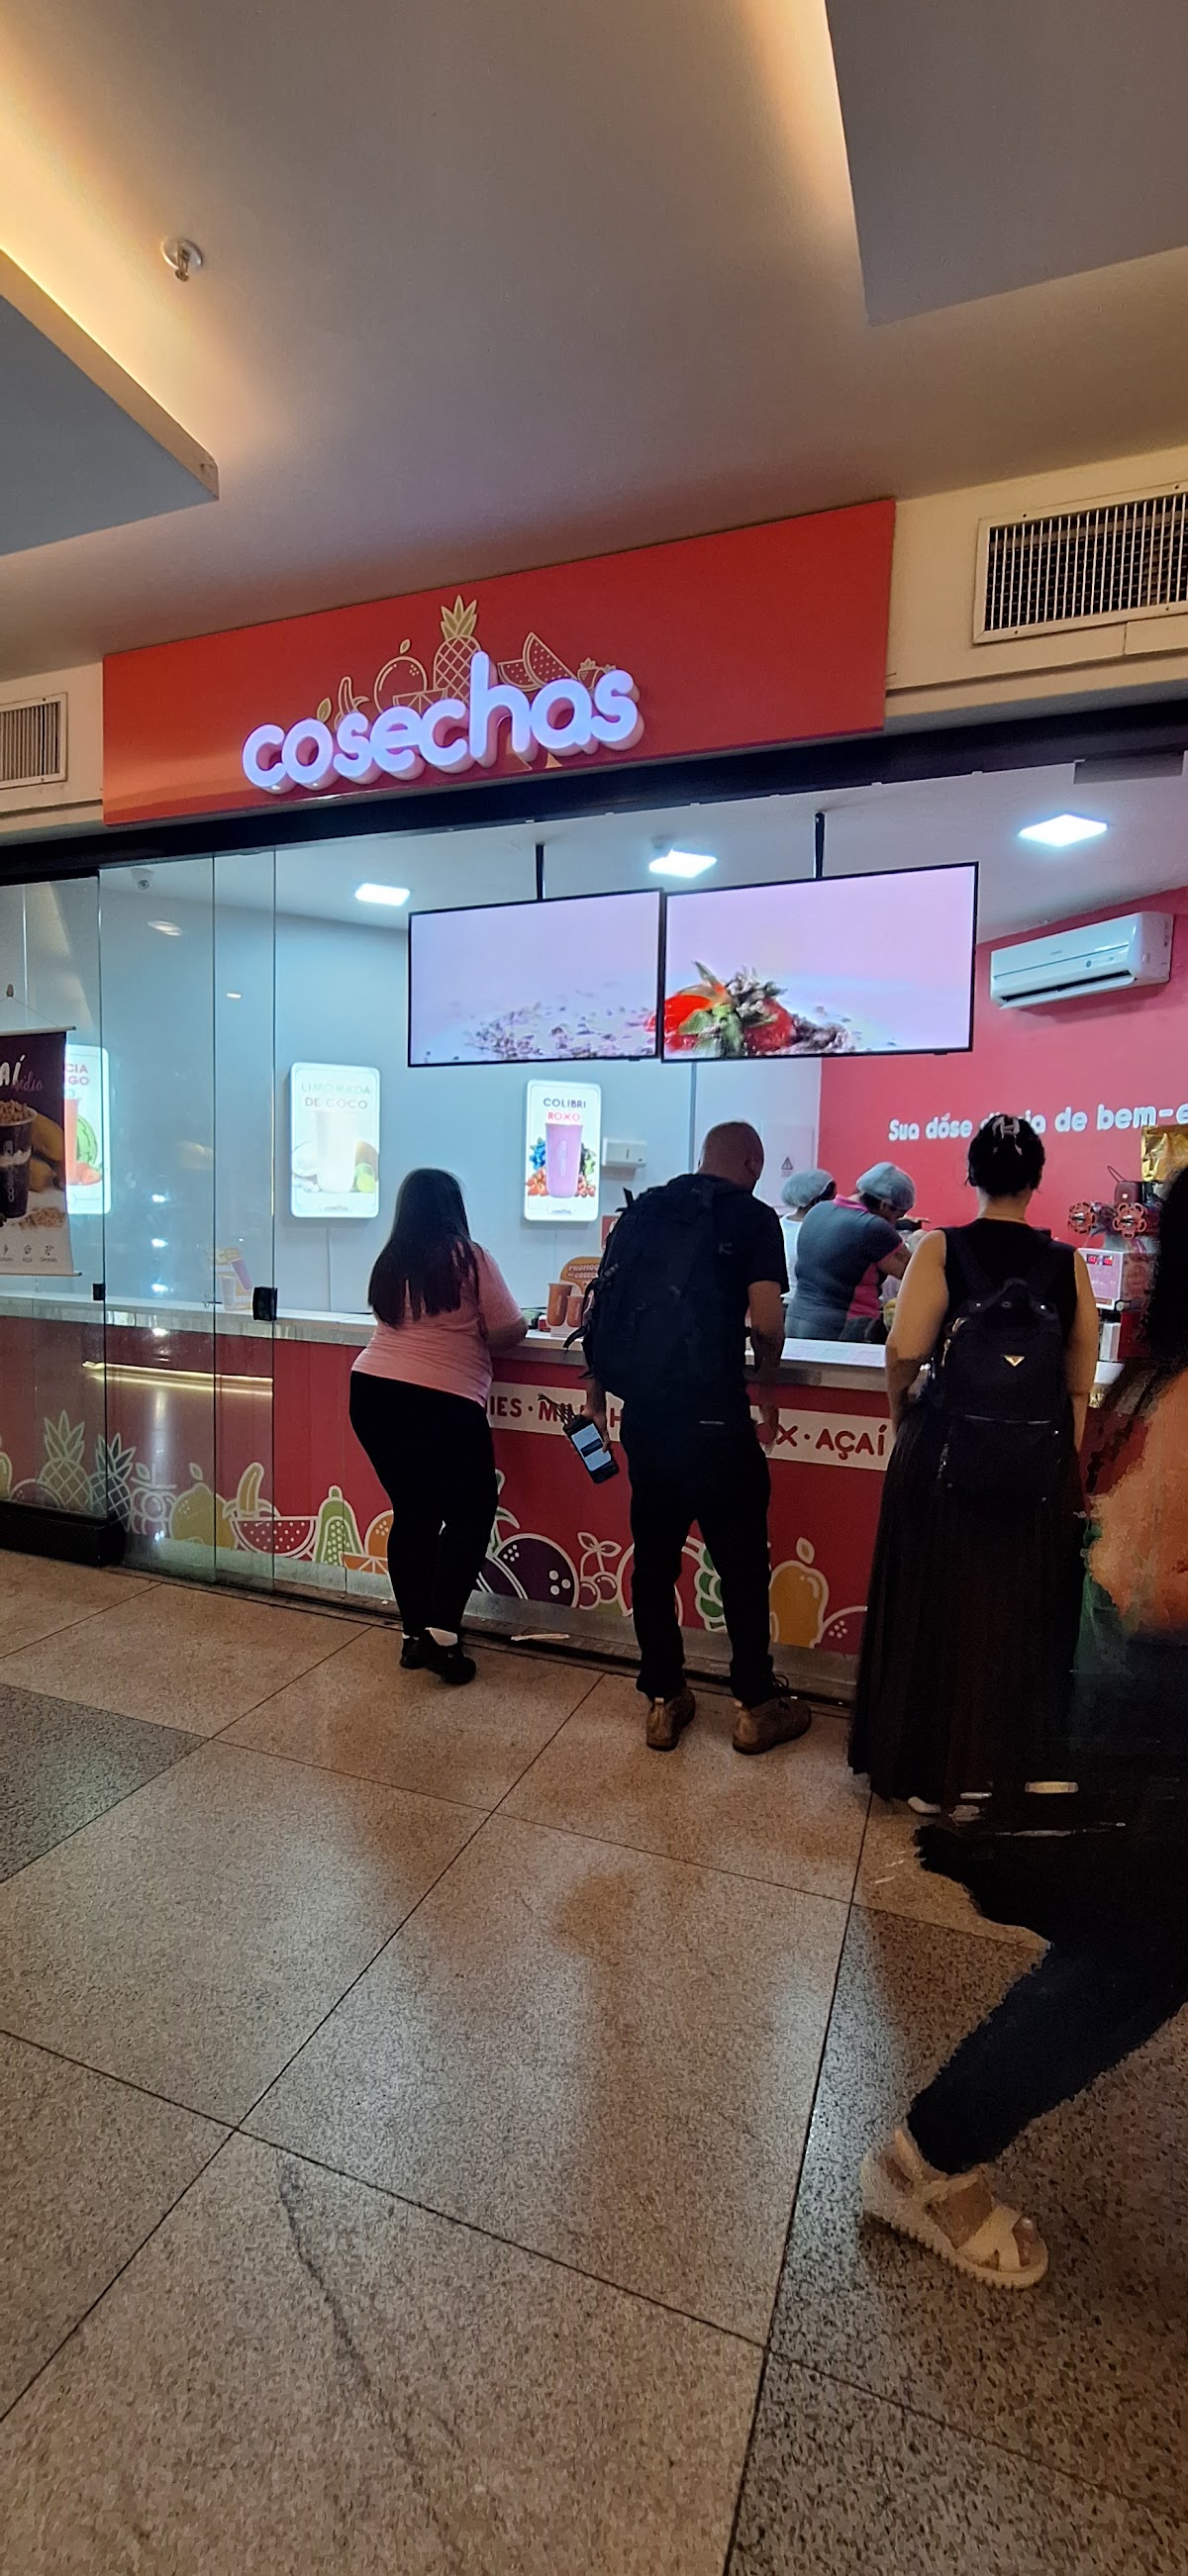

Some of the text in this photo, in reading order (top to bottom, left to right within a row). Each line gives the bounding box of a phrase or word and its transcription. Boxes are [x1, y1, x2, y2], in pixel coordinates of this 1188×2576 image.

[243, 650, 643, 793] cosechas
[0, 1054, 26, 1086] AÍ
[65, 1063, 88, 1074] CIA
[68, 1075, 90, 1086] GO
[305, 1097, 368, 1109] DE COCO
[543, 1097, 587, 1109] COLIBRI
[547, 1111, 580, 1122] ROXO
[888, 1119, 920, 1141] Sua
[1054, 1106, 1088, 1132] de
[490, 1395, 522, 1418] IES
[776, 1424, 798, 1447] X
[815, 1424, 887, 1461] AÇAÍ
